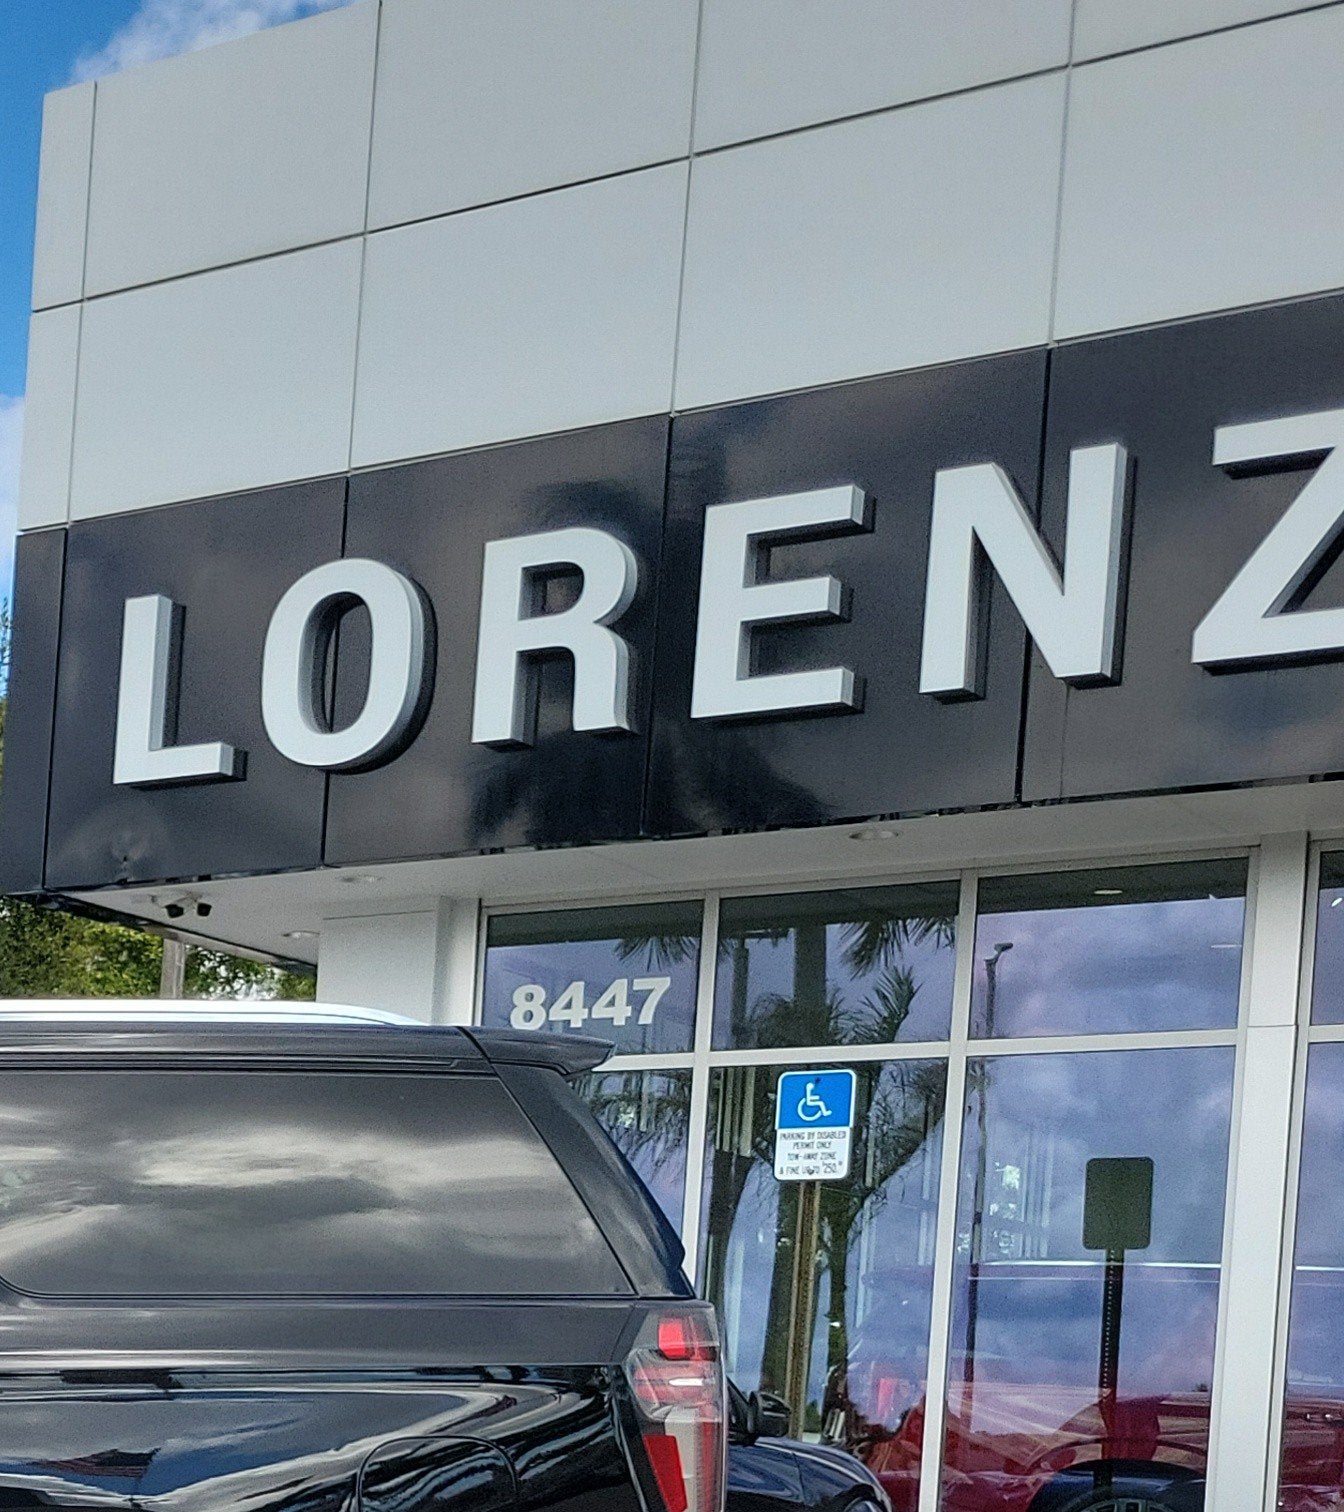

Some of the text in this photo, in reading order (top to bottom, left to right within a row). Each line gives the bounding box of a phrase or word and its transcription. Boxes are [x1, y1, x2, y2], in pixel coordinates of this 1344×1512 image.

[113, 408, 1344, 788] LORENZ
[510, 976, 671, 1031] 8447
[780, 1130, 846, 1140] PARKING BY DISABLED
[793, 1141, 831, 1149] PERMIT ONLY
[787, 1152, 836, 1160] TOW-AWAY ZONE
[786, 1166, 800, 1174] FINE
